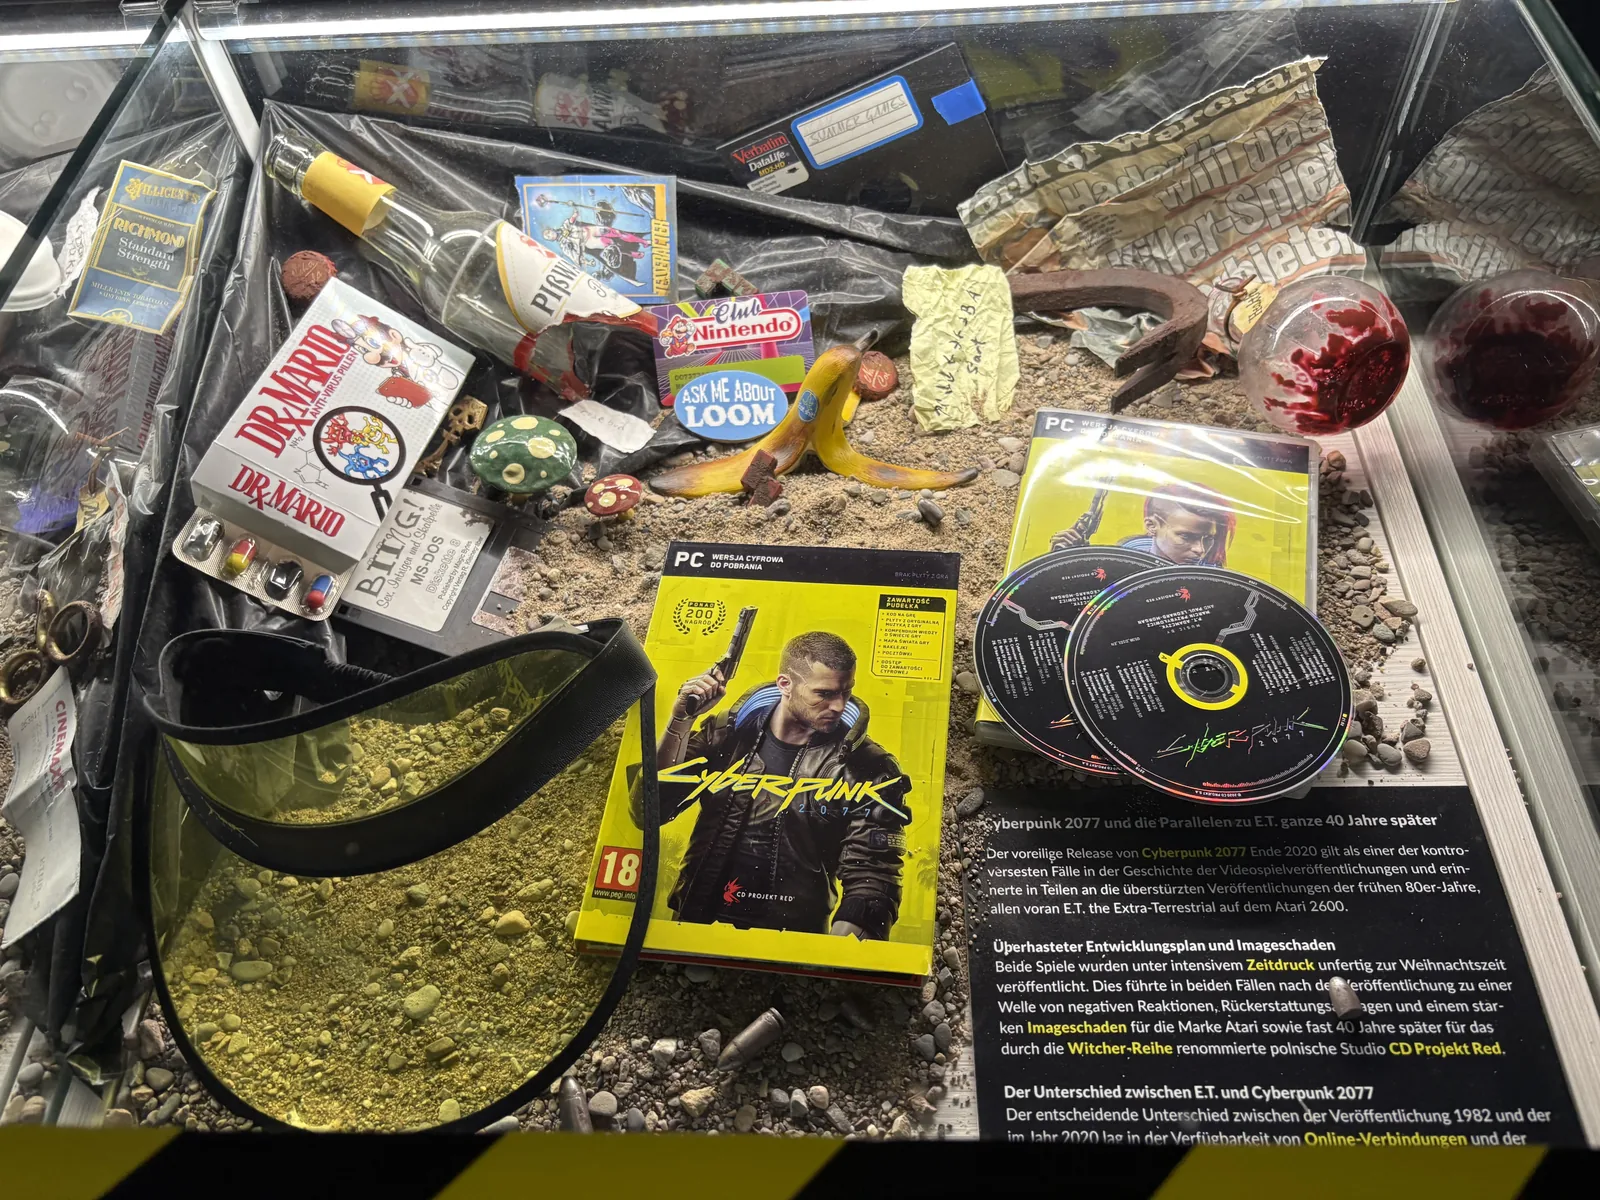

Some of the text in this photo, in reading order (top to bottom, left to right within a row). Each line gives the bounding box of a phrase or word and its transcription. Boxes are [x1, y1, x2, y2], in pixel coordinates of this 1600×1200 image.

[731, 134, 787, 164] Verbatim
[1154, 108, 1326, 209] will das
[113, 217, 186, 248] RICHMOND
[119, 236, 175, 262] Standard
[117, 247, 171, 271] Strength
[715, 299, 762, 324] Club
[309, 350, 360, 425] ANTI-VIRUS PILLEN
[682, 378, 776, 404] ASK ME ABOUT
[684, 403, 776, 428] LOOM
[1045, 417, 1074, 432] PC
[271, 479, 346, 537] MARIO
[414, 503, 443, 540] Skalpelle
[409, 540, 420, 556] und
[410, 536, 444, 586] MS-DOS
[674, 552, 705, 568] PC
[712, 553, 745, 561] WERSJA
[723, 562, 763, 570] POBRANIA
[387, 557, 413, 589] Intrigen
[426, 549, 456, 594] Diskette
[437, 575, 455, 601] Published
[453, 553, 467, 570] Magic
[461, 540, 473, 555] Bytes
[886, 596, 931, 605] ZAWARTOŚĆ
[685, 609, 713, 619] 200
[1137, 610, 1187, 624] LEONARD-MORGAN
[1189, 610, 1210, 619] MARCIN
[1258, 730, 1304, 747] 2077
[799, 804, 871, 817] 2077
[1065, 814, 1100, 828] 2077
[1105, 814, 1131, 828] und
[1135, 814, 1156, 828] die
[1160, 813, 1232, 828] Parallelen
[1235, 817, 1251, 827] zu
[1255, 814, 1277, 827] E.T.
[1281, 815, 1323, 829] ganze
[1326, 813, 1344, 826] 40
[1348, 812, 1387, 826] Jahre
[1391, 811, 1437, 829] später
[603, 851, 640, 887] 18
[593, 889, 636, 900] www.pegi.info
[736, 891, 746, 899] CD
[748, 892, 778, 901] PROJEKT
[994, 936, 1335, 955] Überhasteter Entwicklungsplan und Imageschaden
[998, 998, 1503, 1016] Welle von negativen Reaktionen, Rückerstattungsagen und einem star-
[1000, 1041, 1506, 1058] durch die Witcher-Reihe renommierte polnische Studio CD Projekt Red.
[1005, 1085, 1373, 1103] Der Unterschied zwischen E.T. und Cyberpunk 2077
